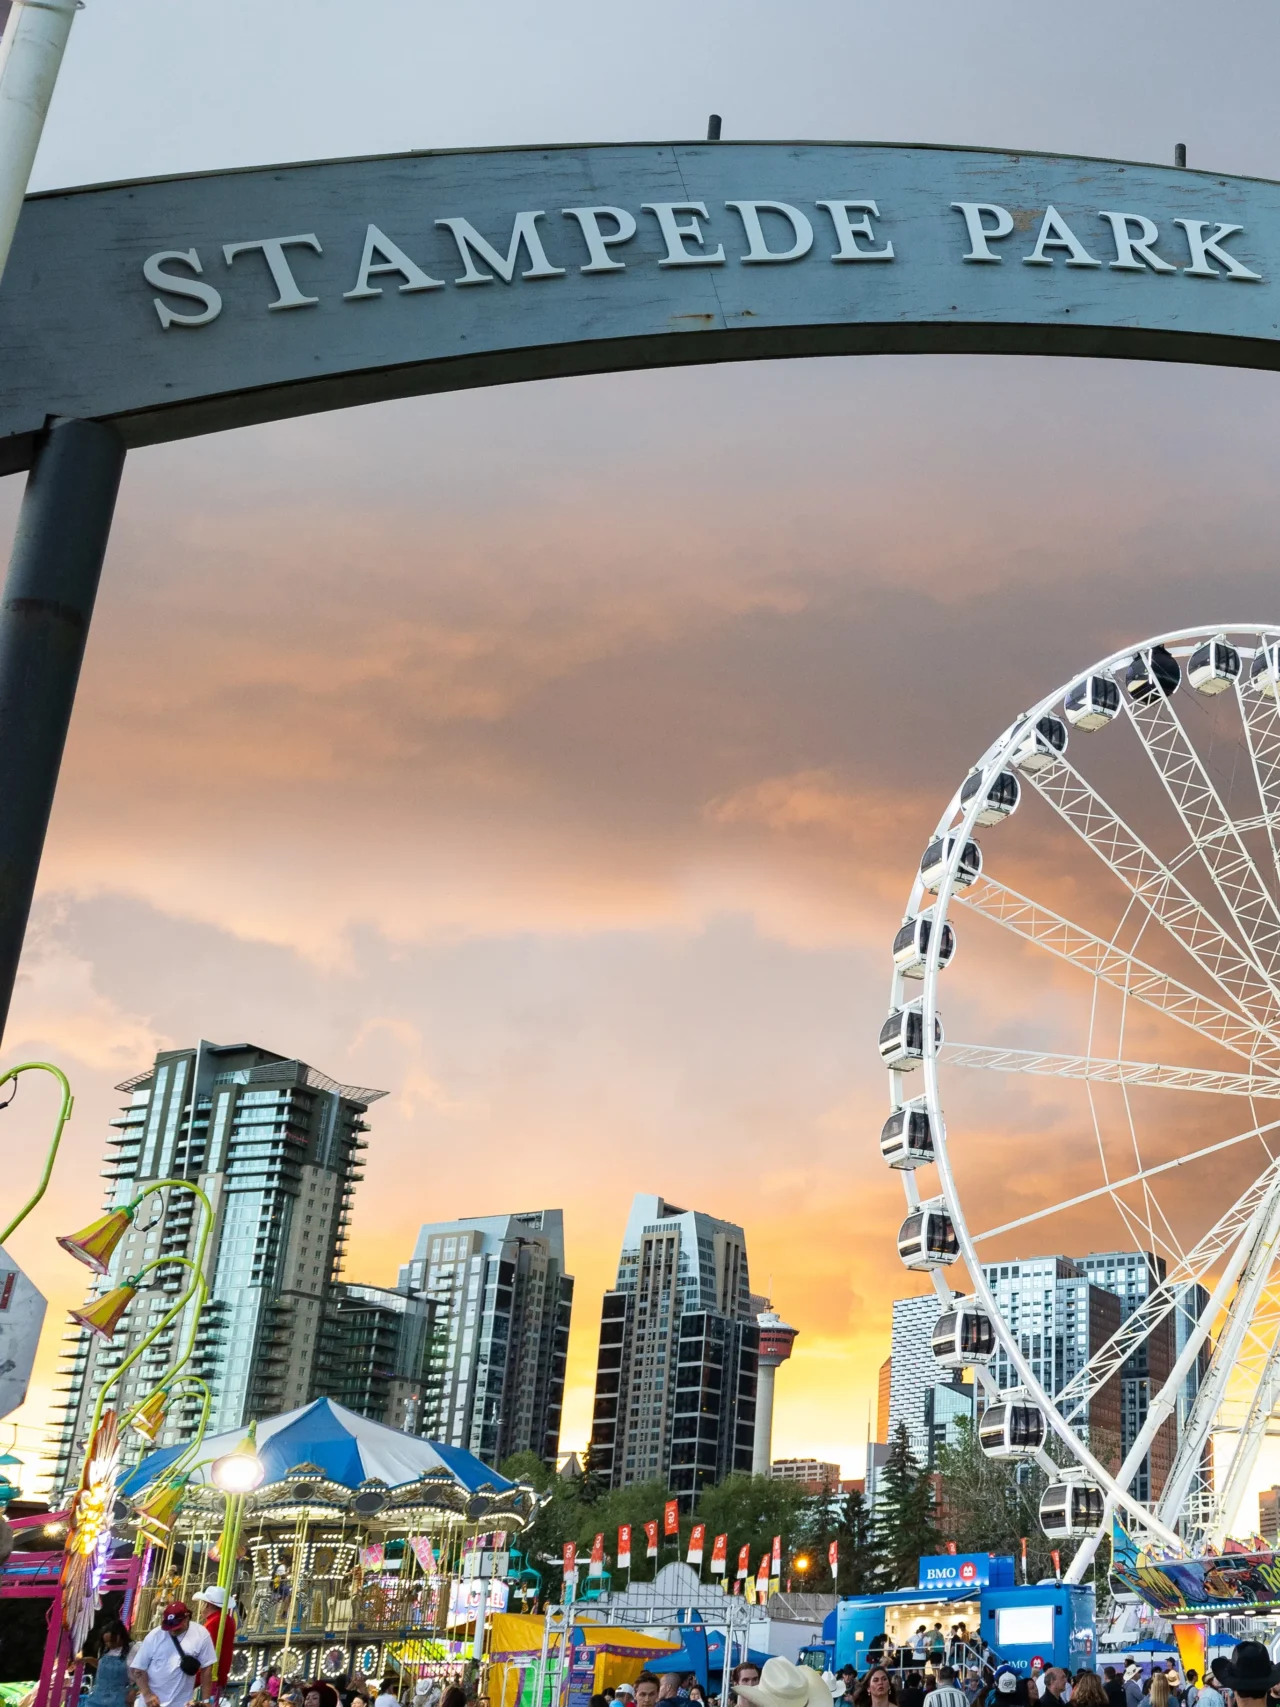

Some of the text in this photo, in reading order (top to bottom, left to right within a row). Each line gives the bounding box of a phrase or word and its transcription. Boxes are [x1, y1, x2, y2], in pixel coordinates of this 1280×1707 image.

[143, 199, 1263, 330] STAMPEDE PARK
[927, 1567, 956, 1580] BMO
[581, 1651, 588, 1661] 6
